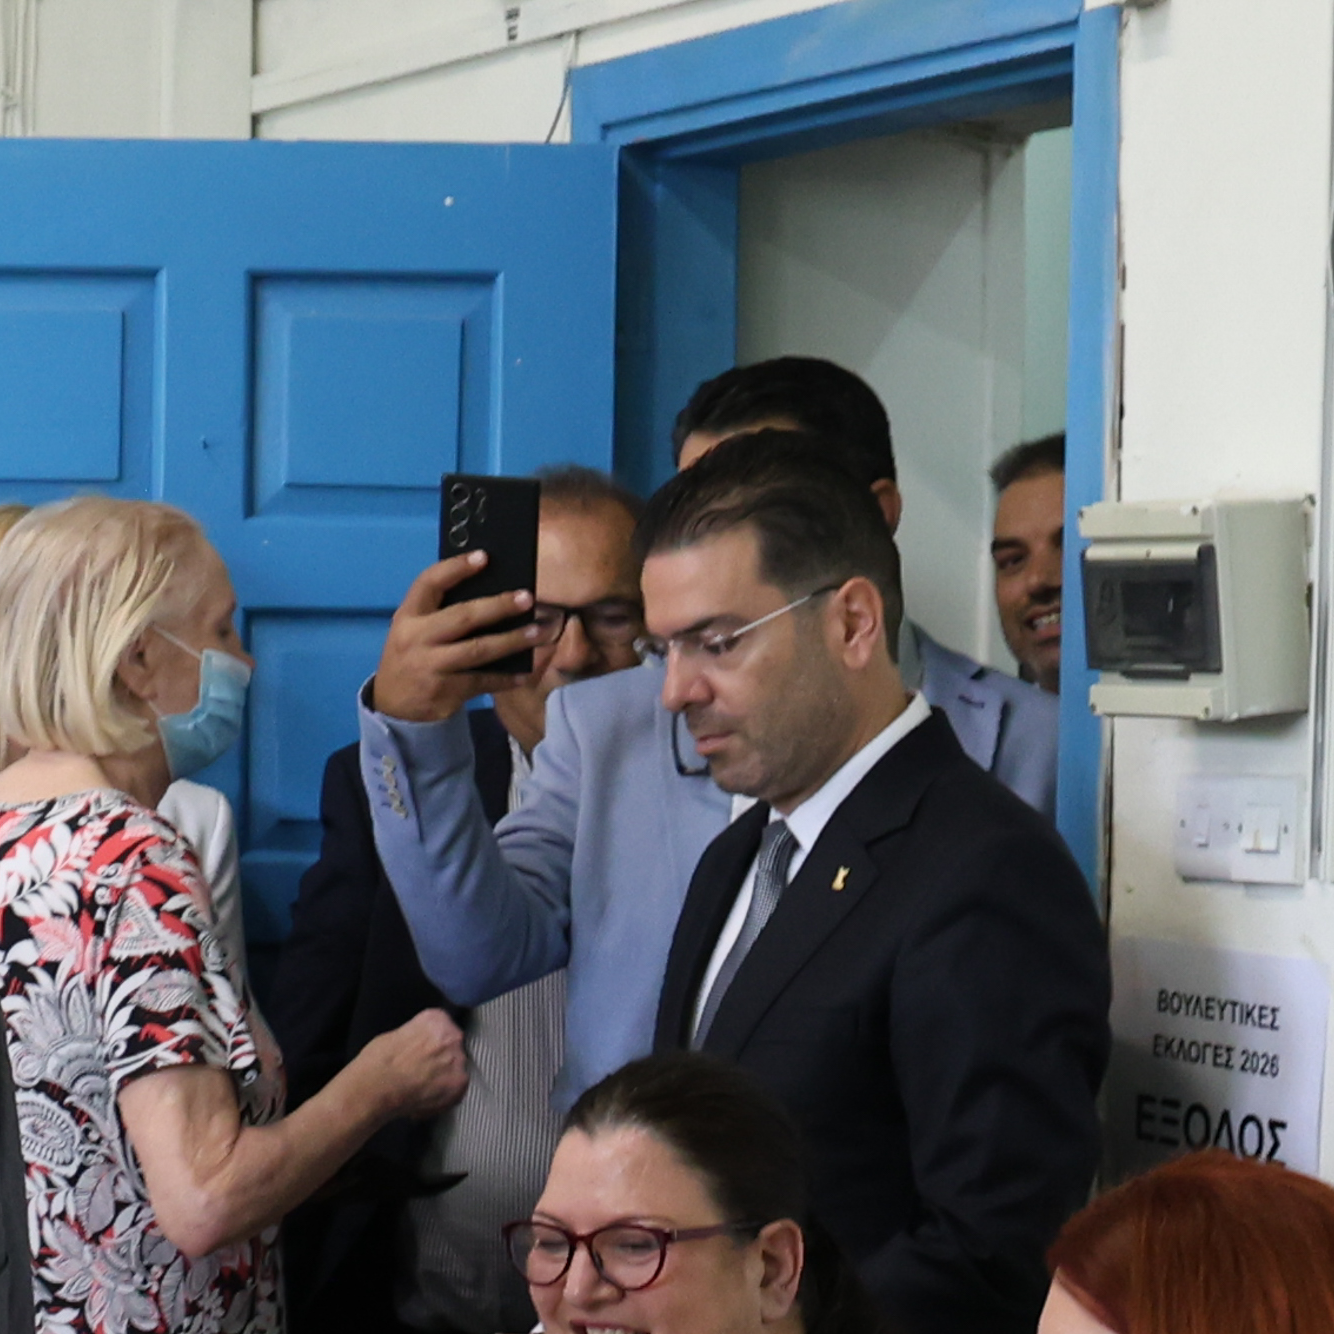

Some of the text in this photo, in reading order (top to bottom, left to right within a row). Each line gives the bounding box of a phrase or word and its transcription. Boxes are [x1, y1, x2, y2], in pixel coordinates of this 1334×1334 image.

[1157, 989, 1280, 1031] ΒΟΥΛΕΥΤΙΚΕΣ
[1153, 1034, 1279, 1078] ΕΚΛΟΓΕΣ 2026
